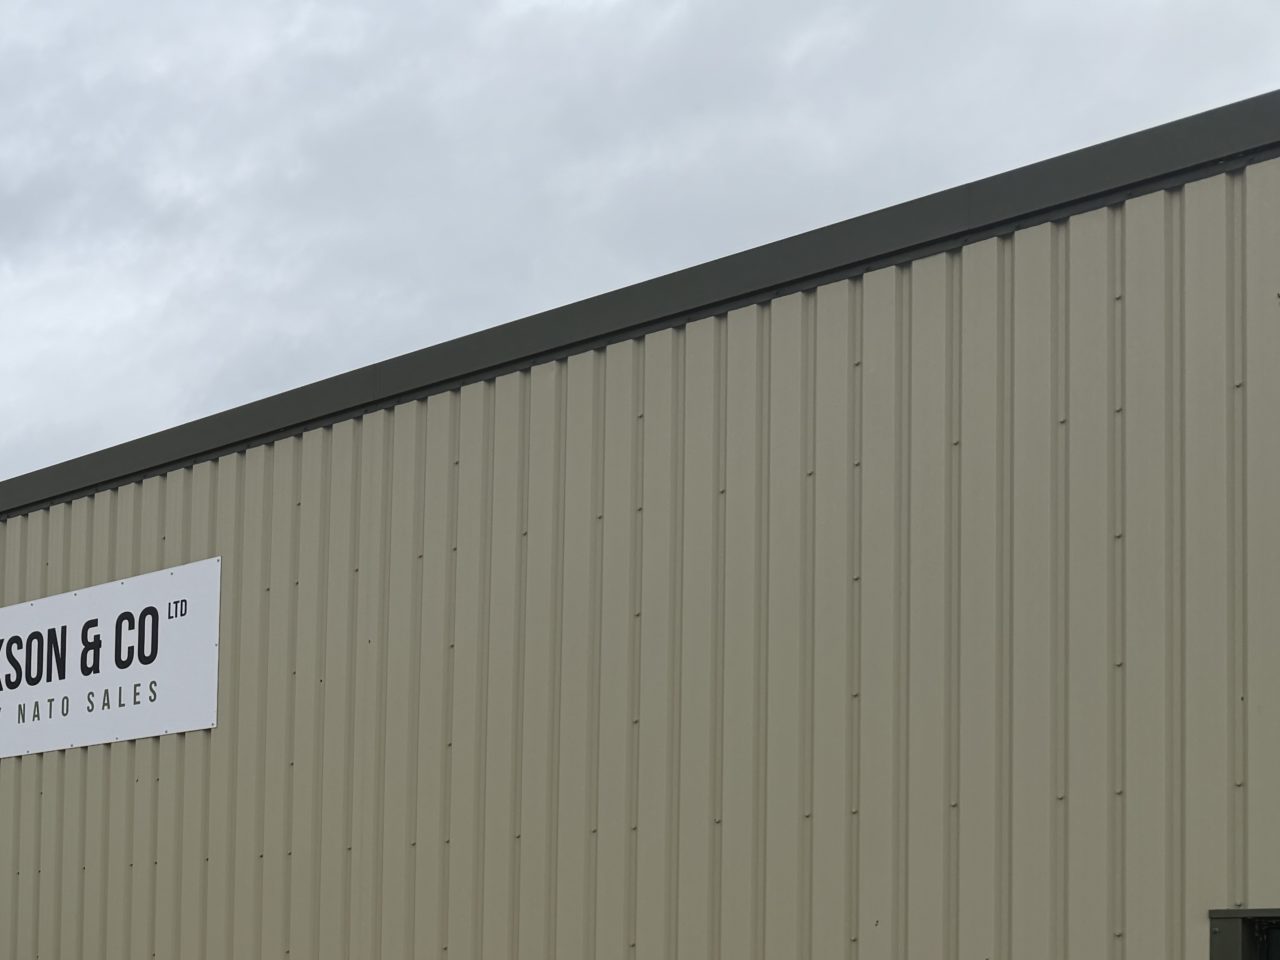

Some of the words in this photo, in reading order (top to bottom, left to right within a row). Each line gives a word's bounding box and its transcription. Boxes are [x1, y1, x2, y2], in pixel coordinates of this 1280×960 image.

[80, 618, 102, 676] &
[114, 606, 159, 669] CO
[168, 599, 187, 619] LTD
[17, 696, 69, 724] NATO
[86, 680, 157, 712] SALES
